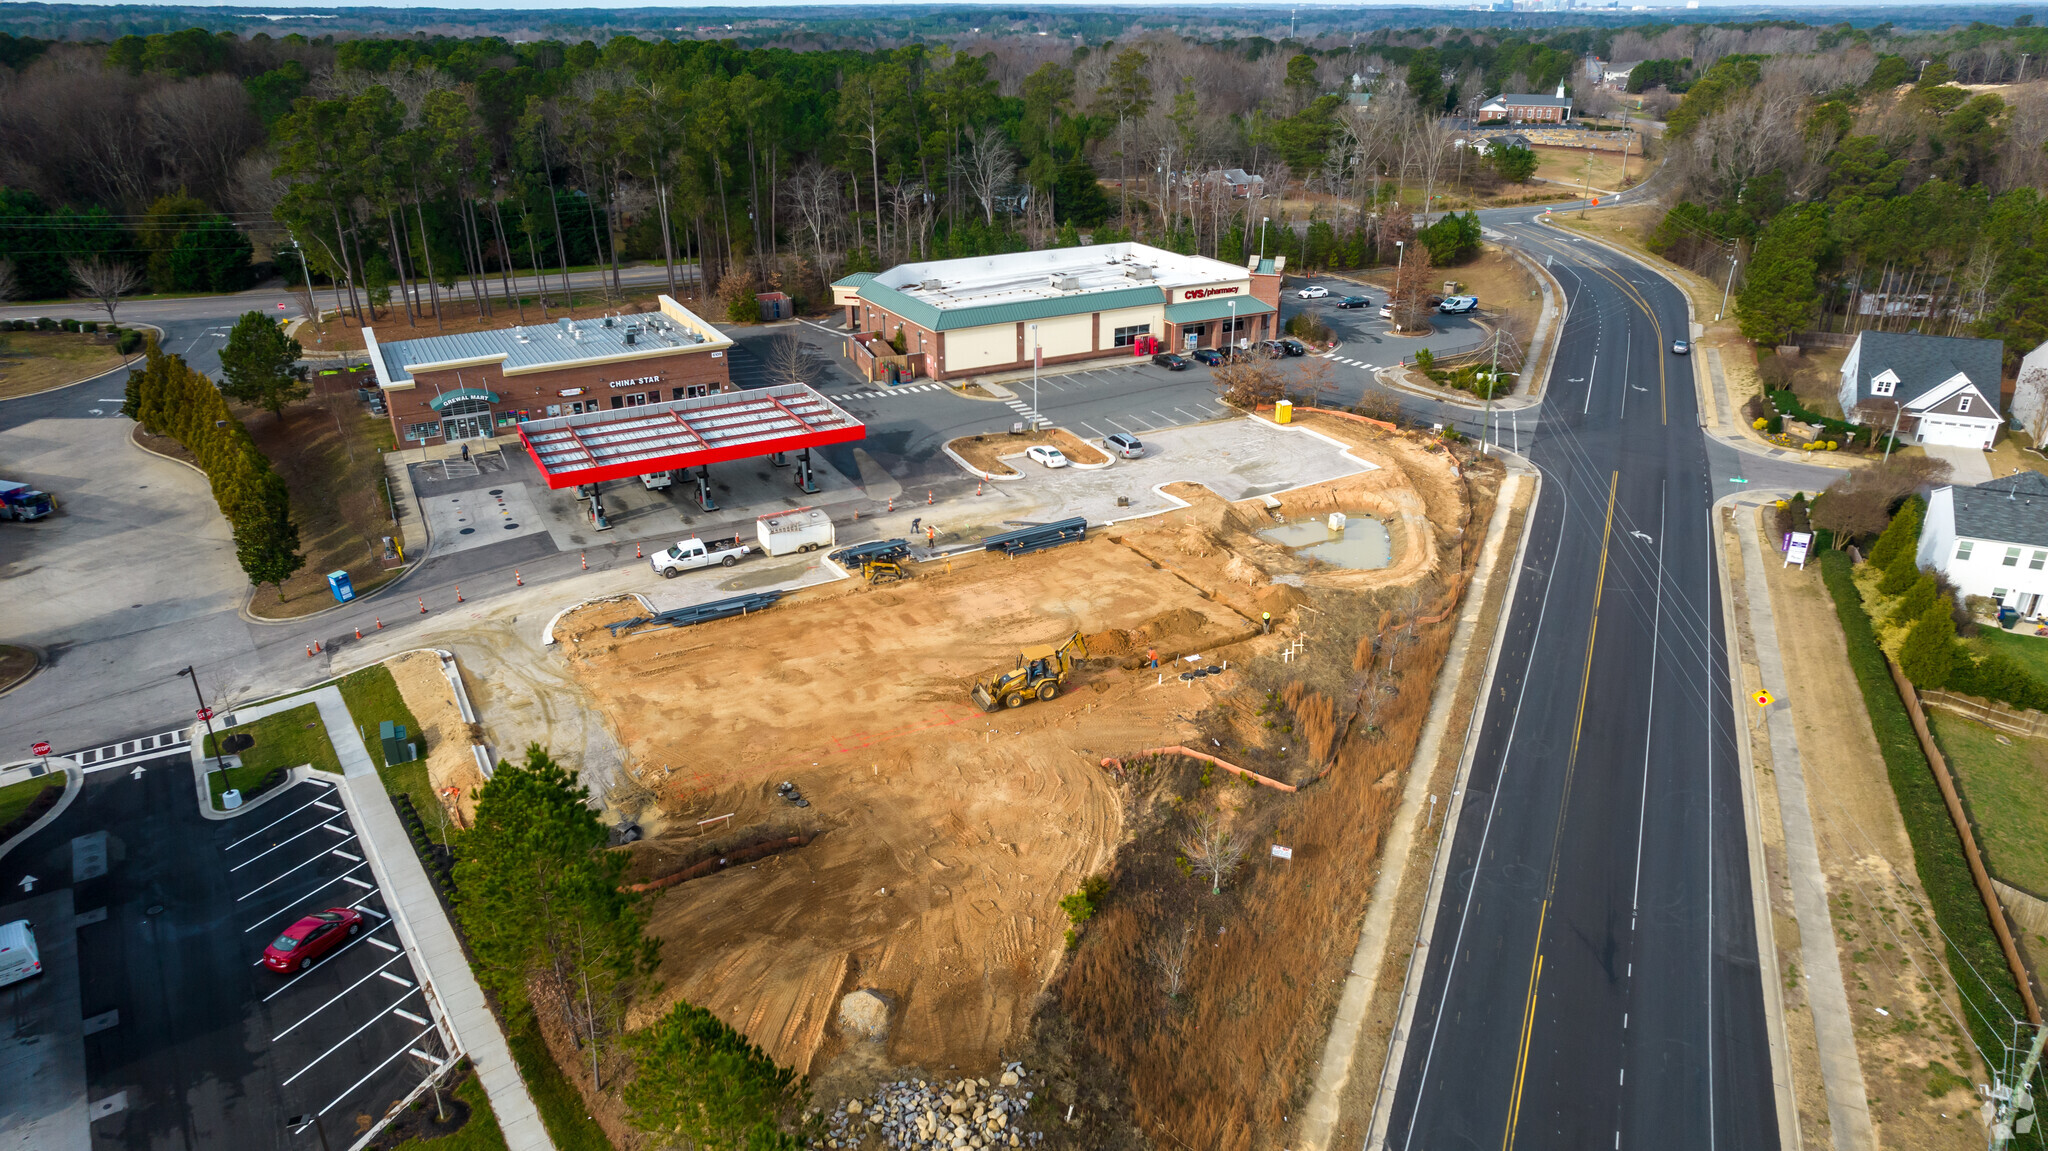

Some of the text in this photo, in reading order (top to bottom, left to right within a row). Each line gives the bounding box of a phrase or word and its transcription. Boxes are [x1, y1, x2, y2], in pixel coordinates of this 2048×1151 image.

[1185, 287, 1239, 299] CVS/pharmacy
[609, 376, 659, 388] CHINA STAR
[443, 395, 469, 406] GREWAL
[33, 745, 50, 753] STOP
